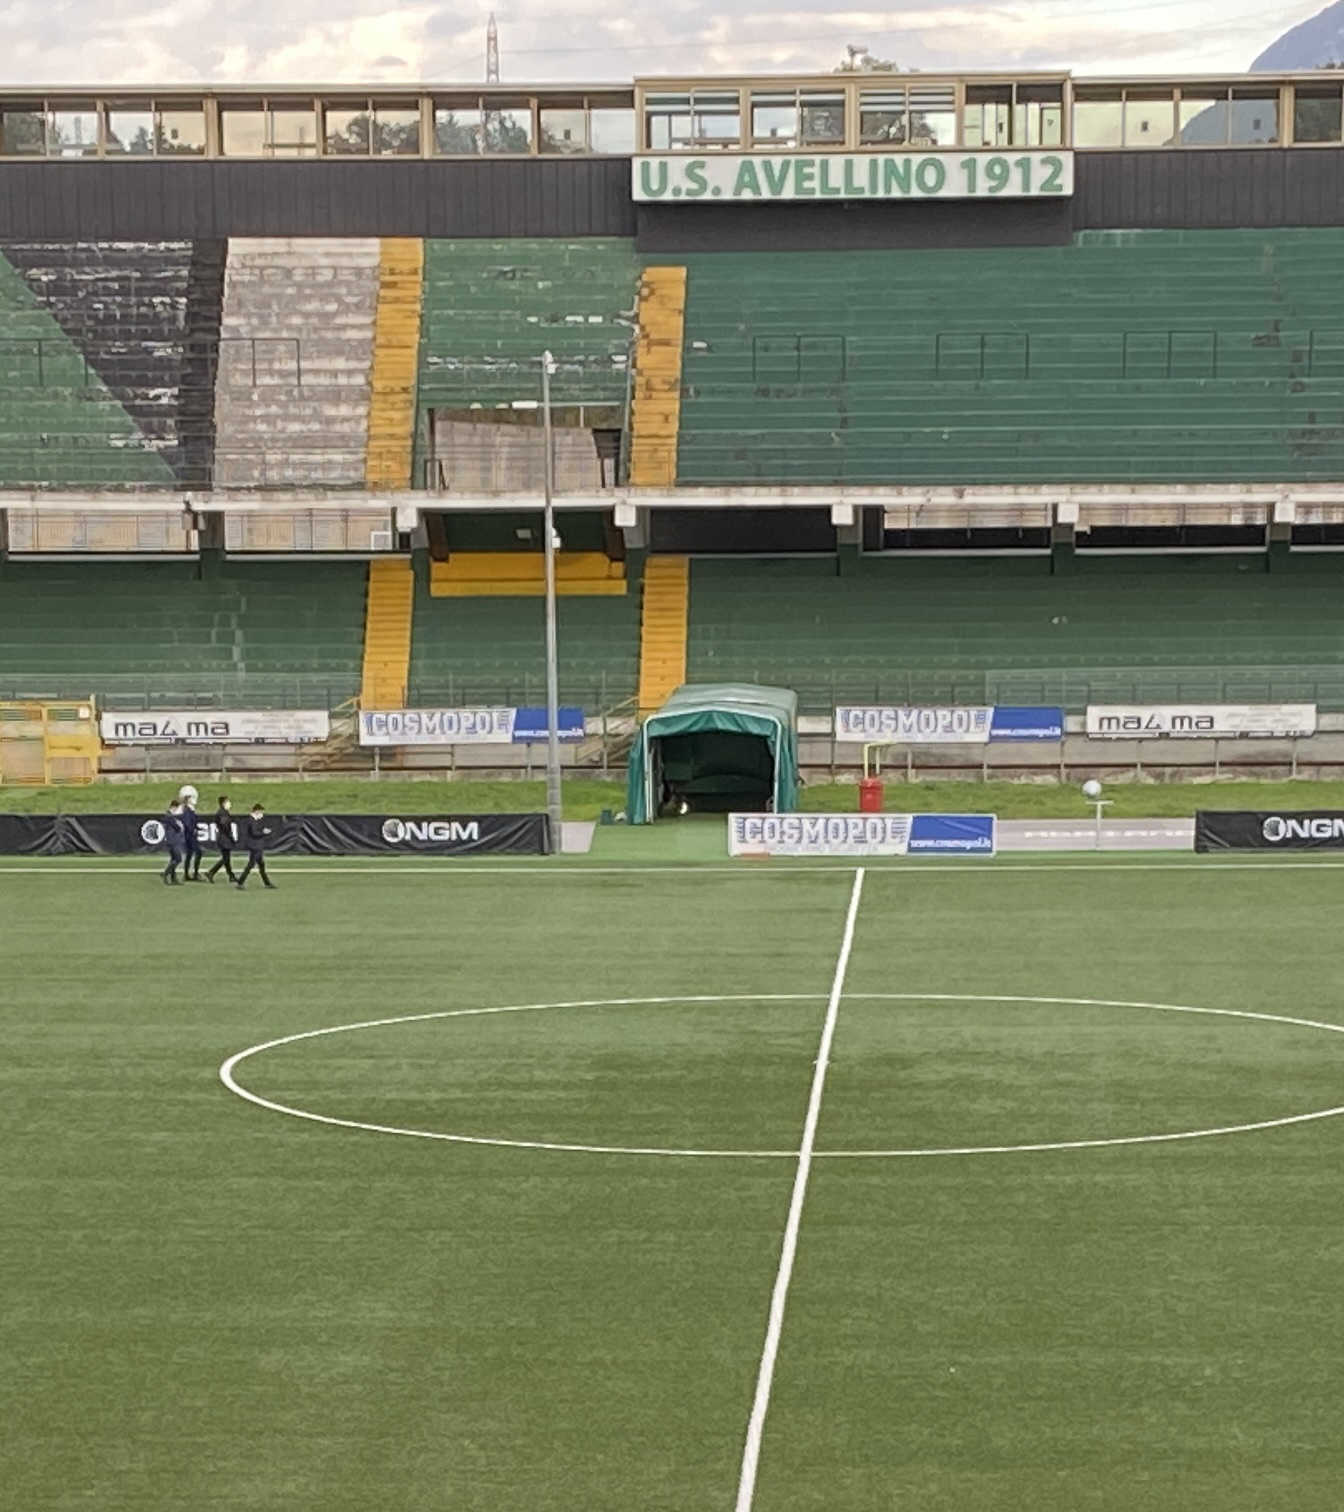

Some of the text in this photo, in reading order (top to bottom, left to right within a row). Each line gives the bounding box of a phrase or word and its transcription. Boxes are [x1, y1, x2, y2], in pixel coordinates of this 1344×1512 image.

[640, 155, 1064, 198] U.S. AVELLINO 1912
[372, 711, 505, 736] COSMOPOL
[848, 709, 984, 733] COSMOPOL
[405, 822, 478, 841] NGM
[744, 817, 898, 843] COSMOPOL
